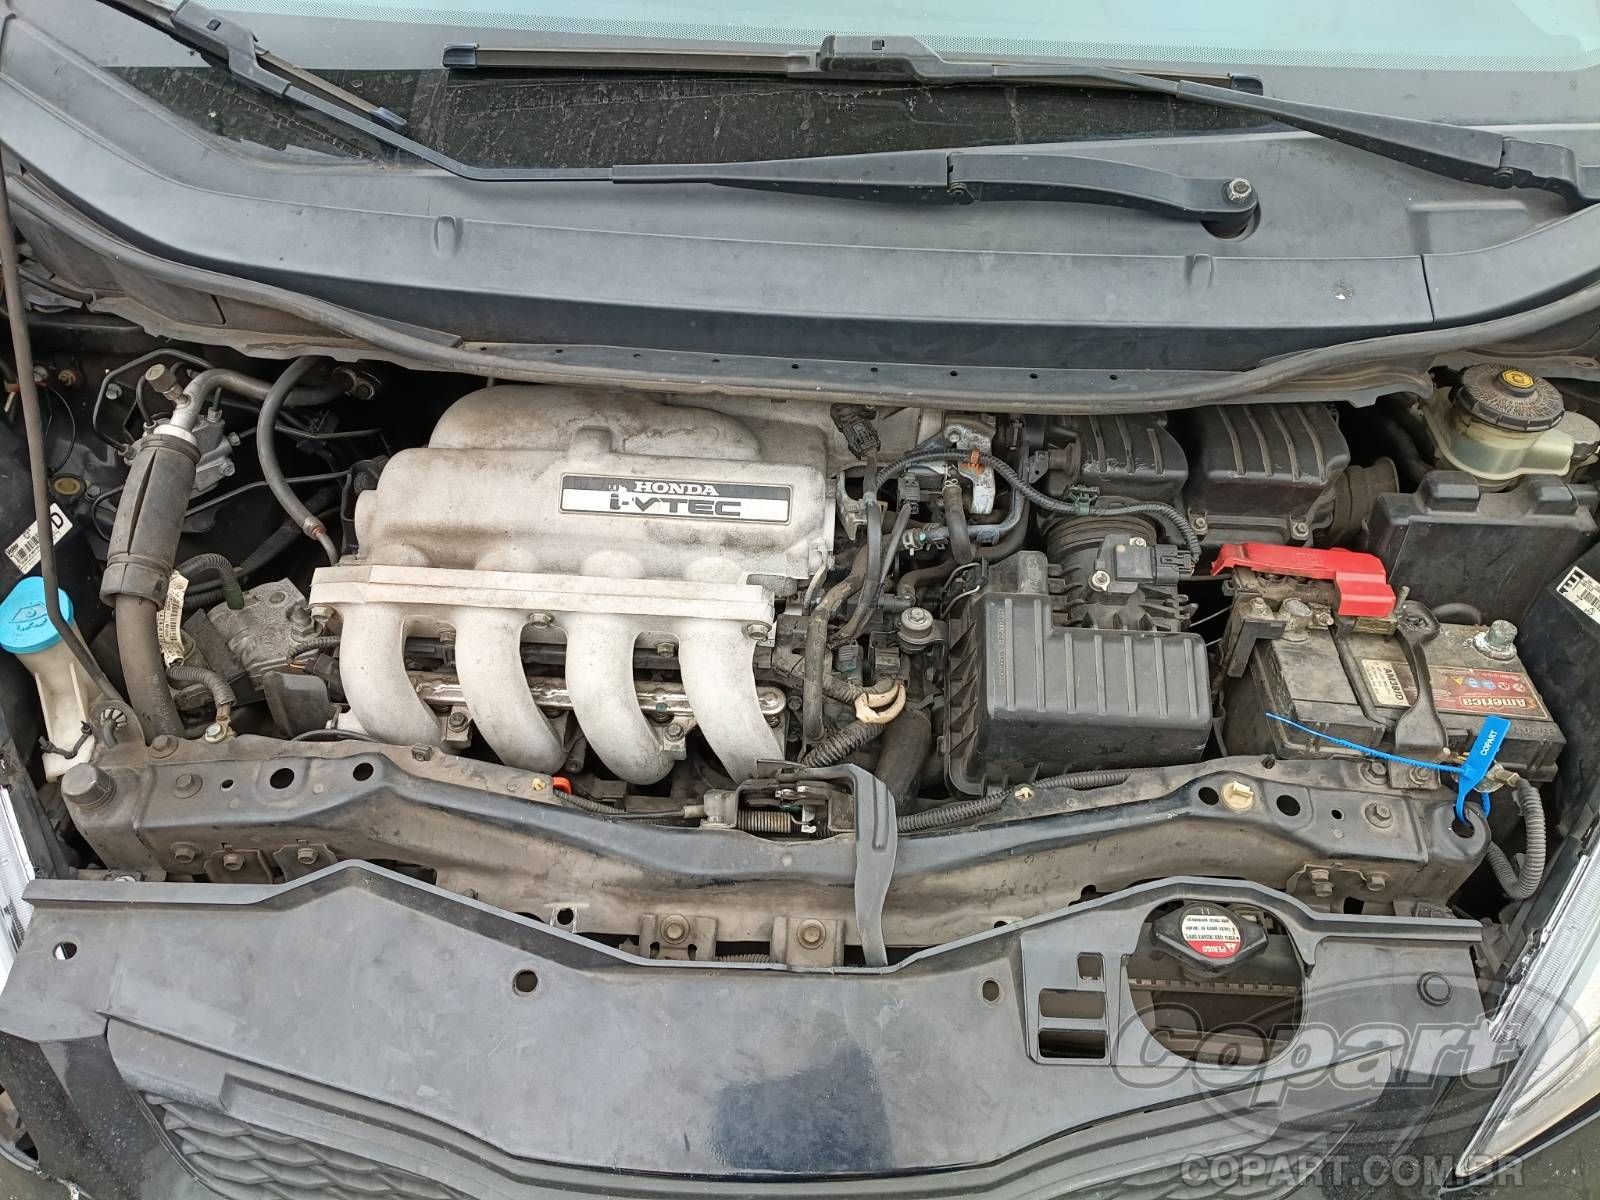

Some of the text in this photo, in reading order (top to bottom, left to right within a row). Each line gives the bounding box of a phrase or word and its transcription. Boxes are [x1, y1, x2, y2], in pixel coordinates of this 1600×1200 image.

[634, 481, 719, 496] HONDA
[609, 492, 741, 516] i-VTEC
[1480, 730, 1498, 756] COPART
